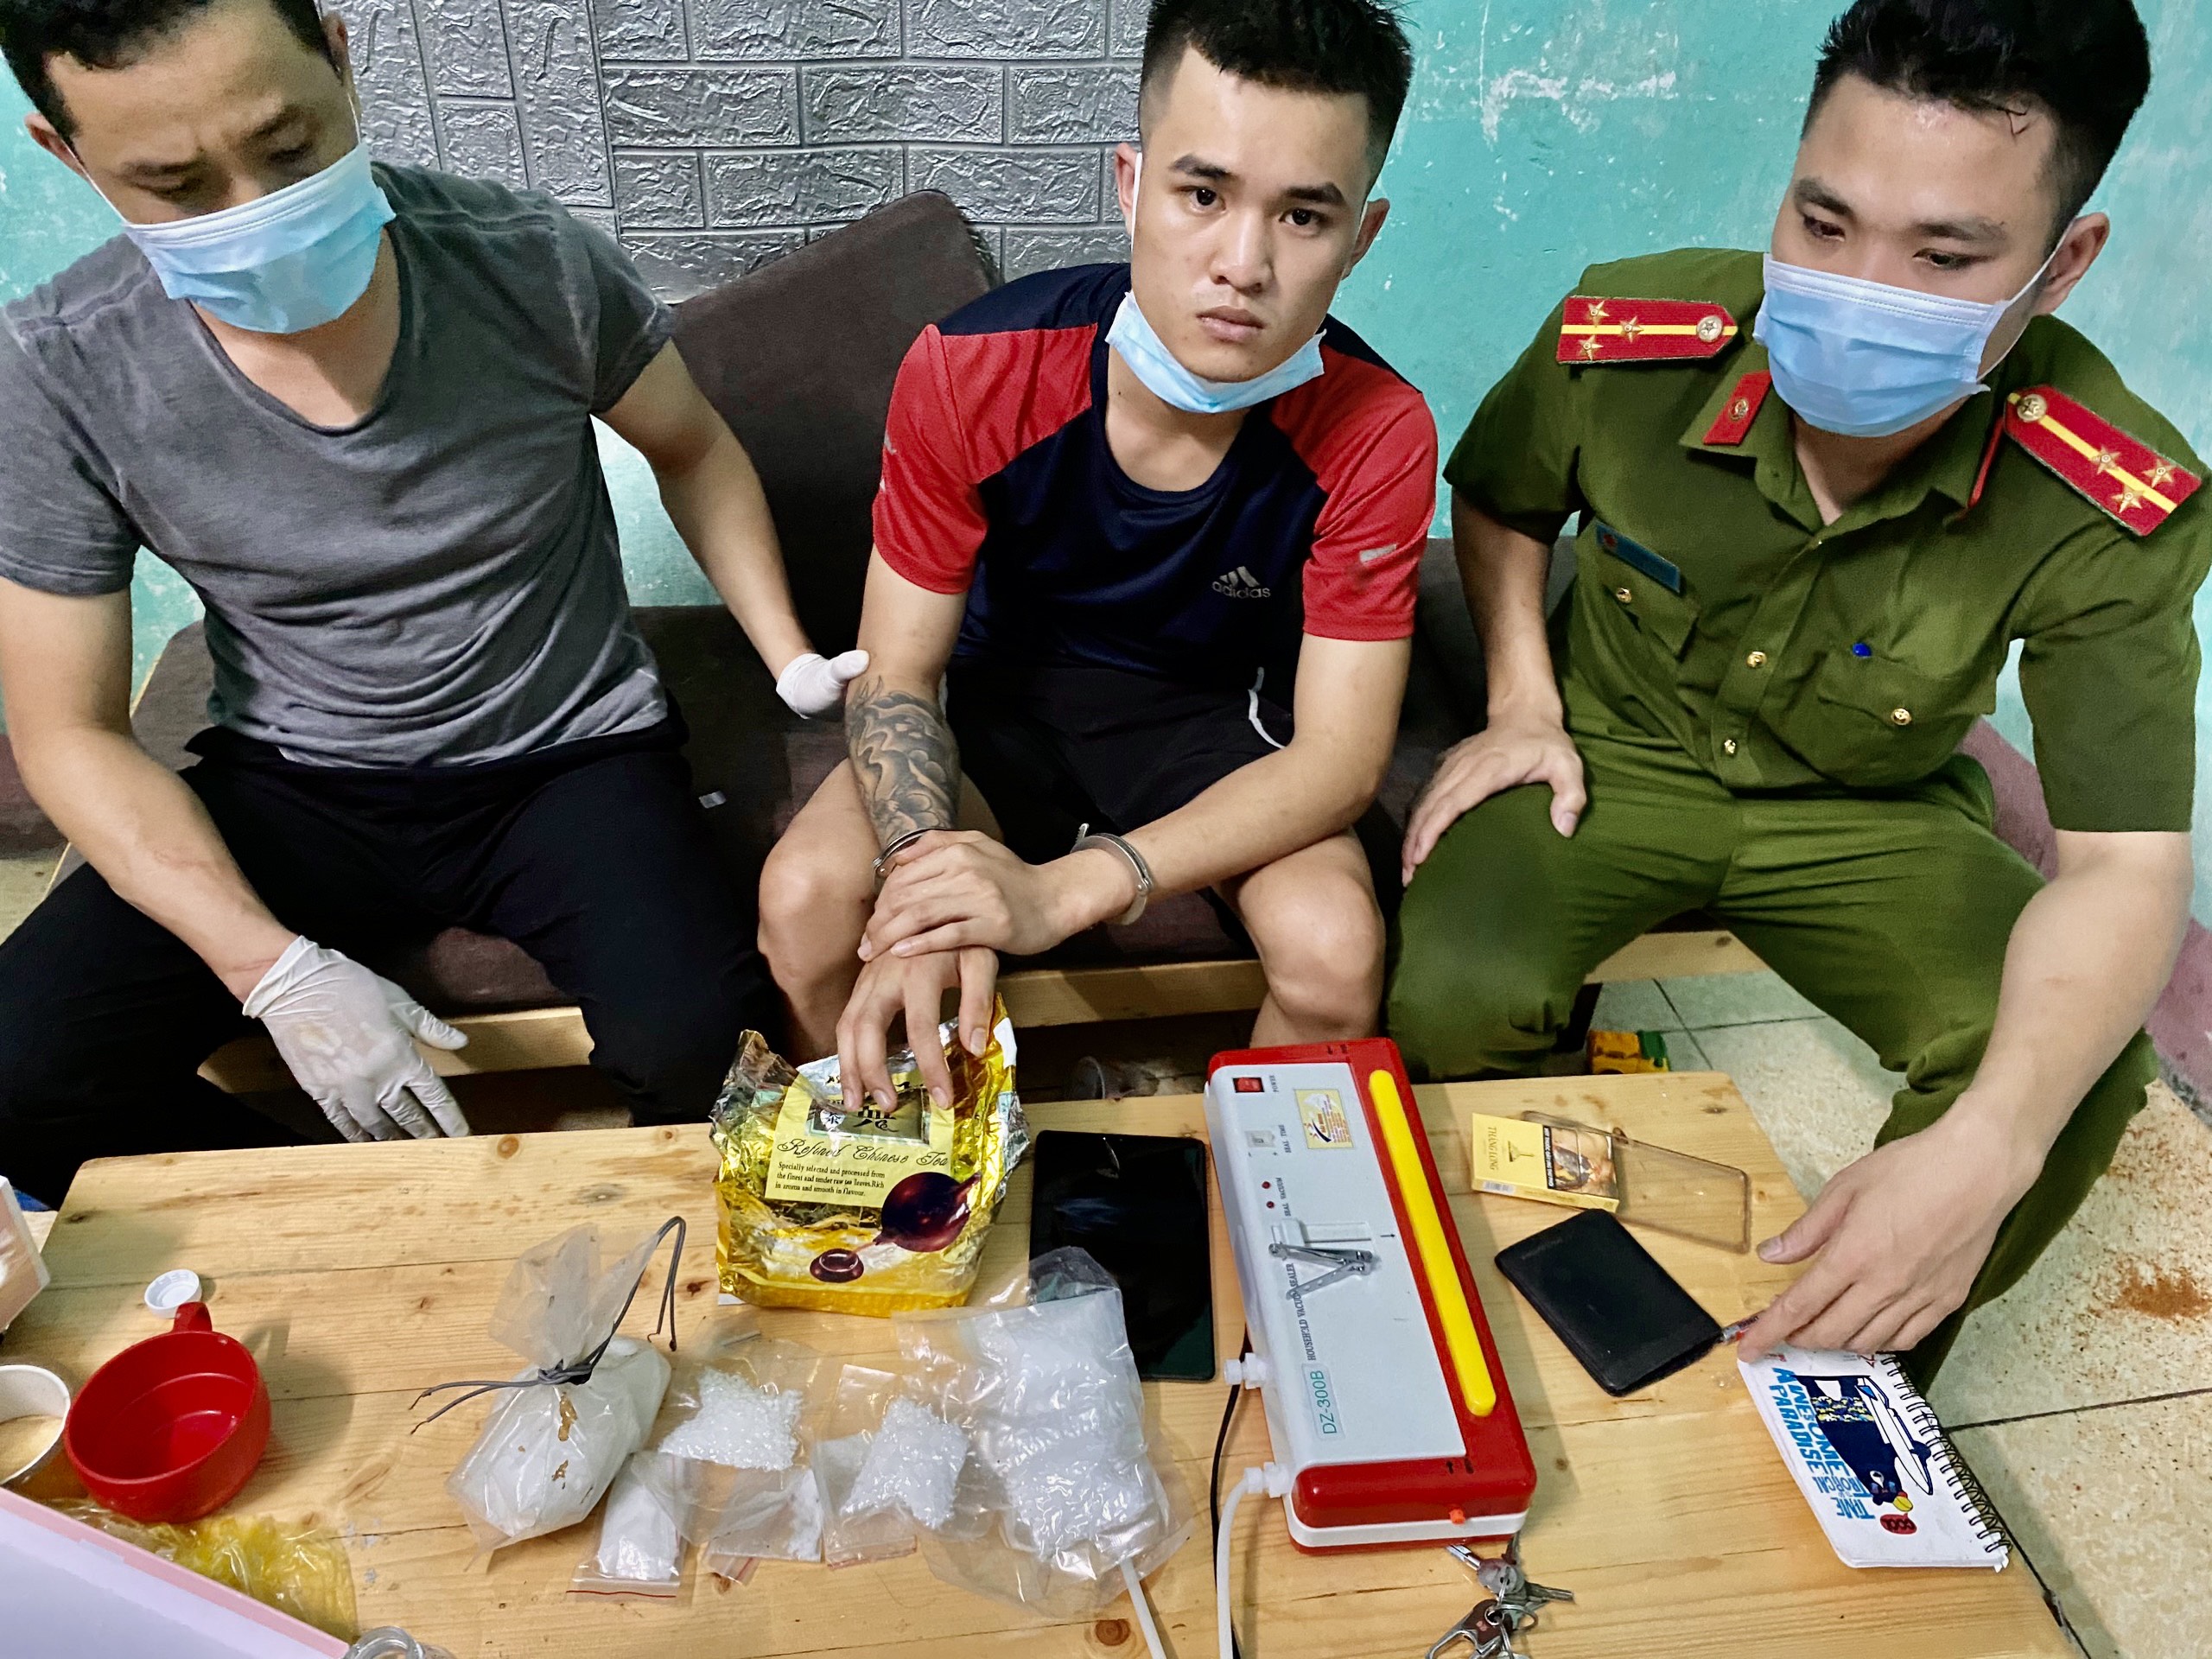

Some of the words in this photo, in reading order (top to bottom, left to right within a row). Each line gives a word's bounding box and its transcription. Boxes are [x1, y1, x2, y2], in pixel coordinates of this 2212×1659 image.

[1212, 581, 1270, 599] adidas
[1269, 1075, 1280, 1092] POWER
[1278, 1124, 1287, 1136] TIME
[777, 1138, 852, 1159] Refined
[852, 1145, 909, 1164] Chinese
[916, 1151, 949, 1166] Tea
[1282, 1140, 1292, 1154] SEAL
[779, 1161, 804, 1173] Specially
[806, 1165, 828, 1173] selected
[842, 1168, 870, 1177] processed
[871, 1170, 886, 1179] from
[1489, 1152, 1499, 1171] LONG
[776, 1180, 780, 1189] in
[787, 1173, 803, 1181] finest
[1275, 1177, 1287, 1199] VACUUM
[1282, 1203, 1292, 1217] SEAL
[1286, 1263, 1299, 1287] SEALER
[1299, 1319, 1317, 1361] HOUSEHOLD
[1310, 1370, 1337, 1434] DZ-300B
[1769, 1384, 1829, 1474] PARADISE
[1771, 1367, 1851, 1476] AWESOME
[1812, 1476, 1874, 1497] TROPICAL
[1830, 1497, 1876, 1519] TIME
